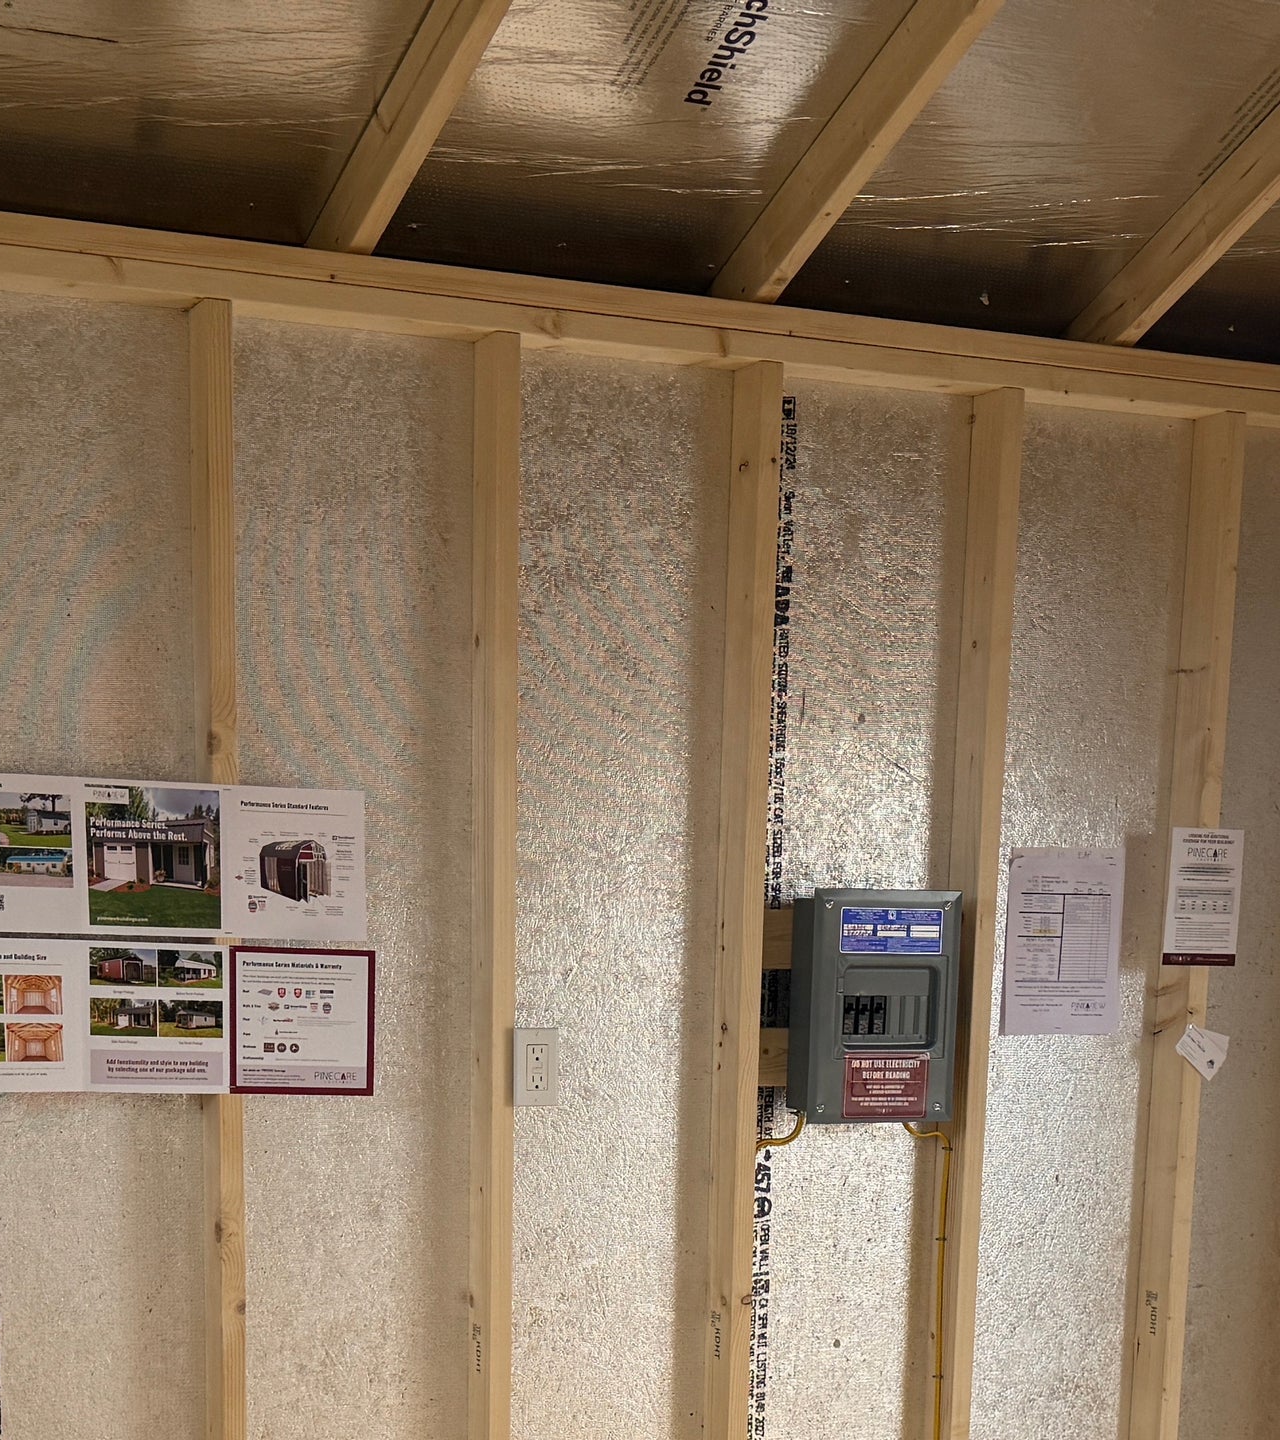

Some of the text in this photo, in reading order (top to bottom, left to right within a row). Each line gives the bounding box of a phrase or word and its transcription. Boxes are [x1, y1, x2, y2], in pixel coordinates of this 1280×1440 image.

[705, 4, 733, 43] BARRIER
[90, 816, 168, 830] Performance Series.
[90, 828, 126, 839] Performs
[128, 829, 152, 840] Above
[153, 830, 167, 840] the
[1187, 847, 1228, 858] PINECARE
[314, 1071, 357, 1081] PINECARE
[757, 1352, 767, 1388] LISTING
